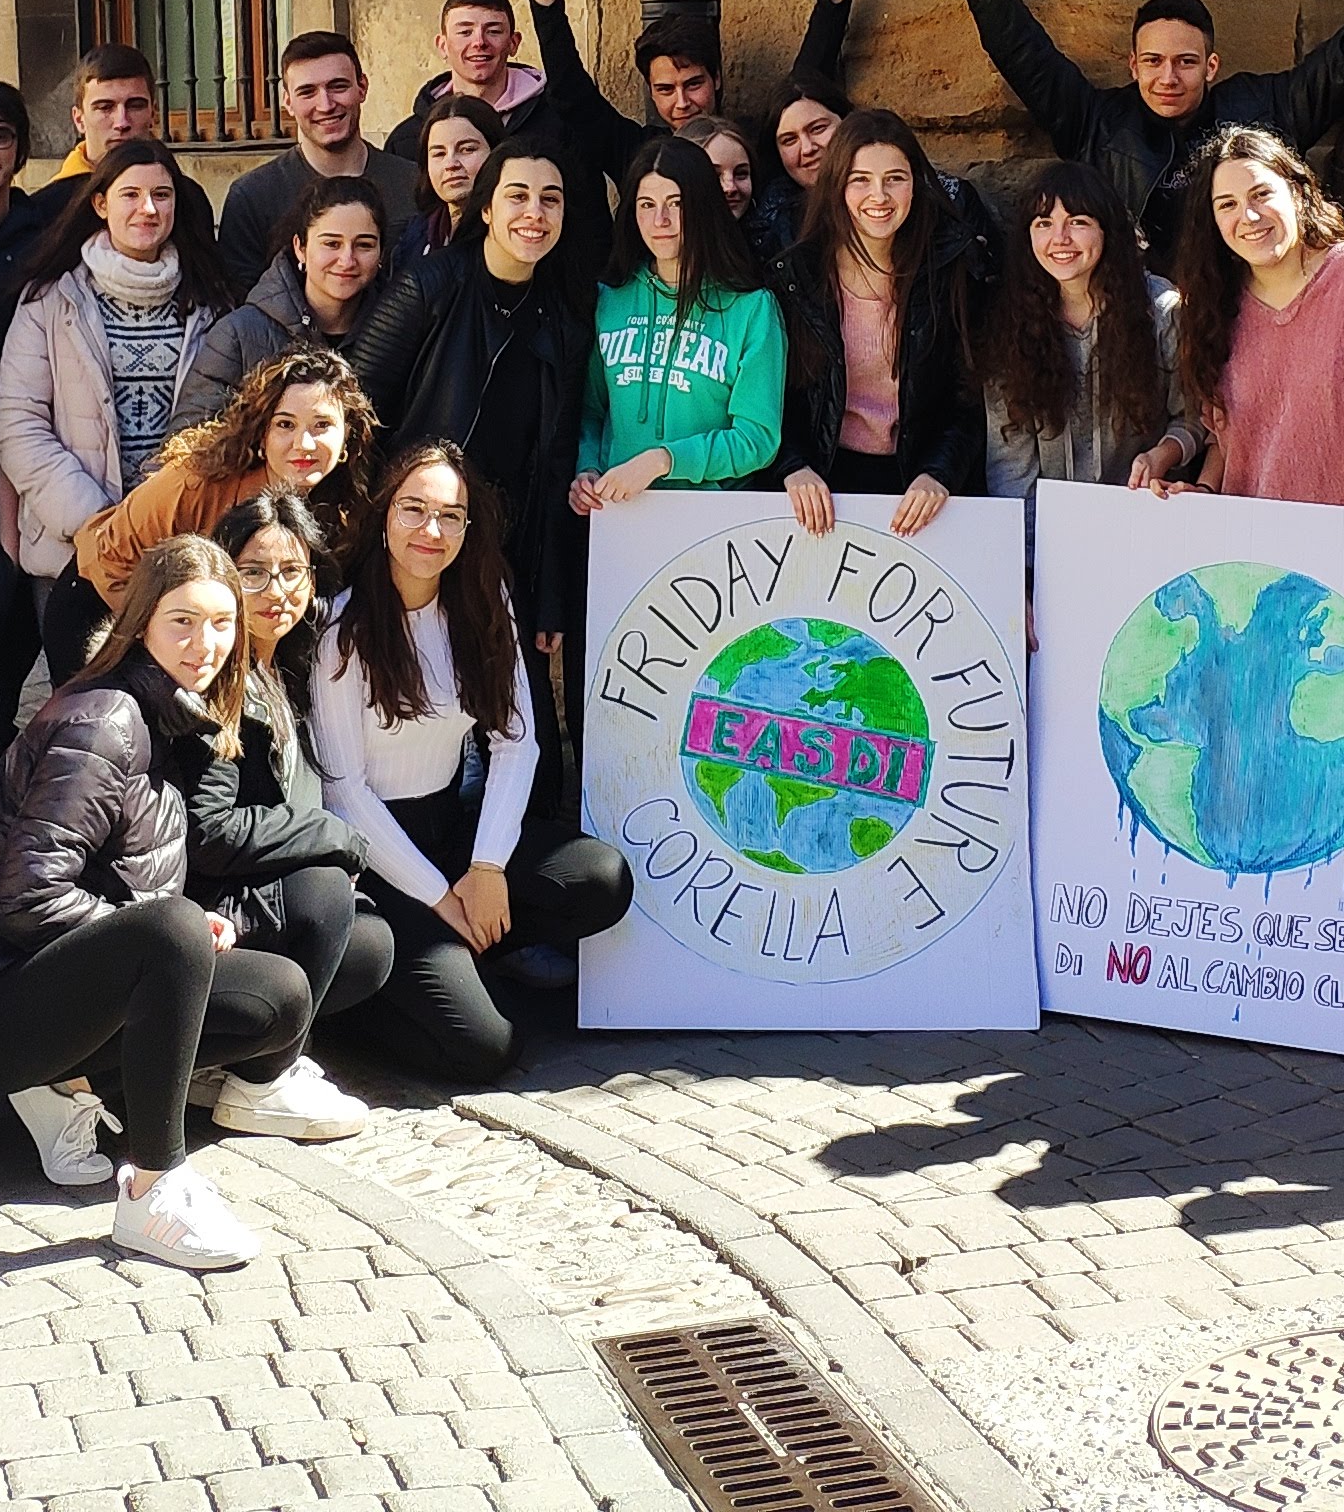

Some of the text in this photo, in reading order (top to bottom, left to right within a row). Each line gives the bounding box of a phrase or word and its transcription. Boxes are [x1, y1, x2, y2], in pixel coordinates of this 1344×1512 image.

[600, 535, 1015, 931] FRIDAY FOR FUTURE
[710, 710, 912, 792] EASDI
[622, 796, 850, 964] CORELLA
[1049, 883, 1107, 928] NO
[1125, 892, 1242, 943] DEJES
[1253, 911, 1311, 949] QUE
[1106, 940, 1152, 986] NO
[1156, 955, 1198, 993] AL
[1202, 959, 1305, 1002] CAMBIO
